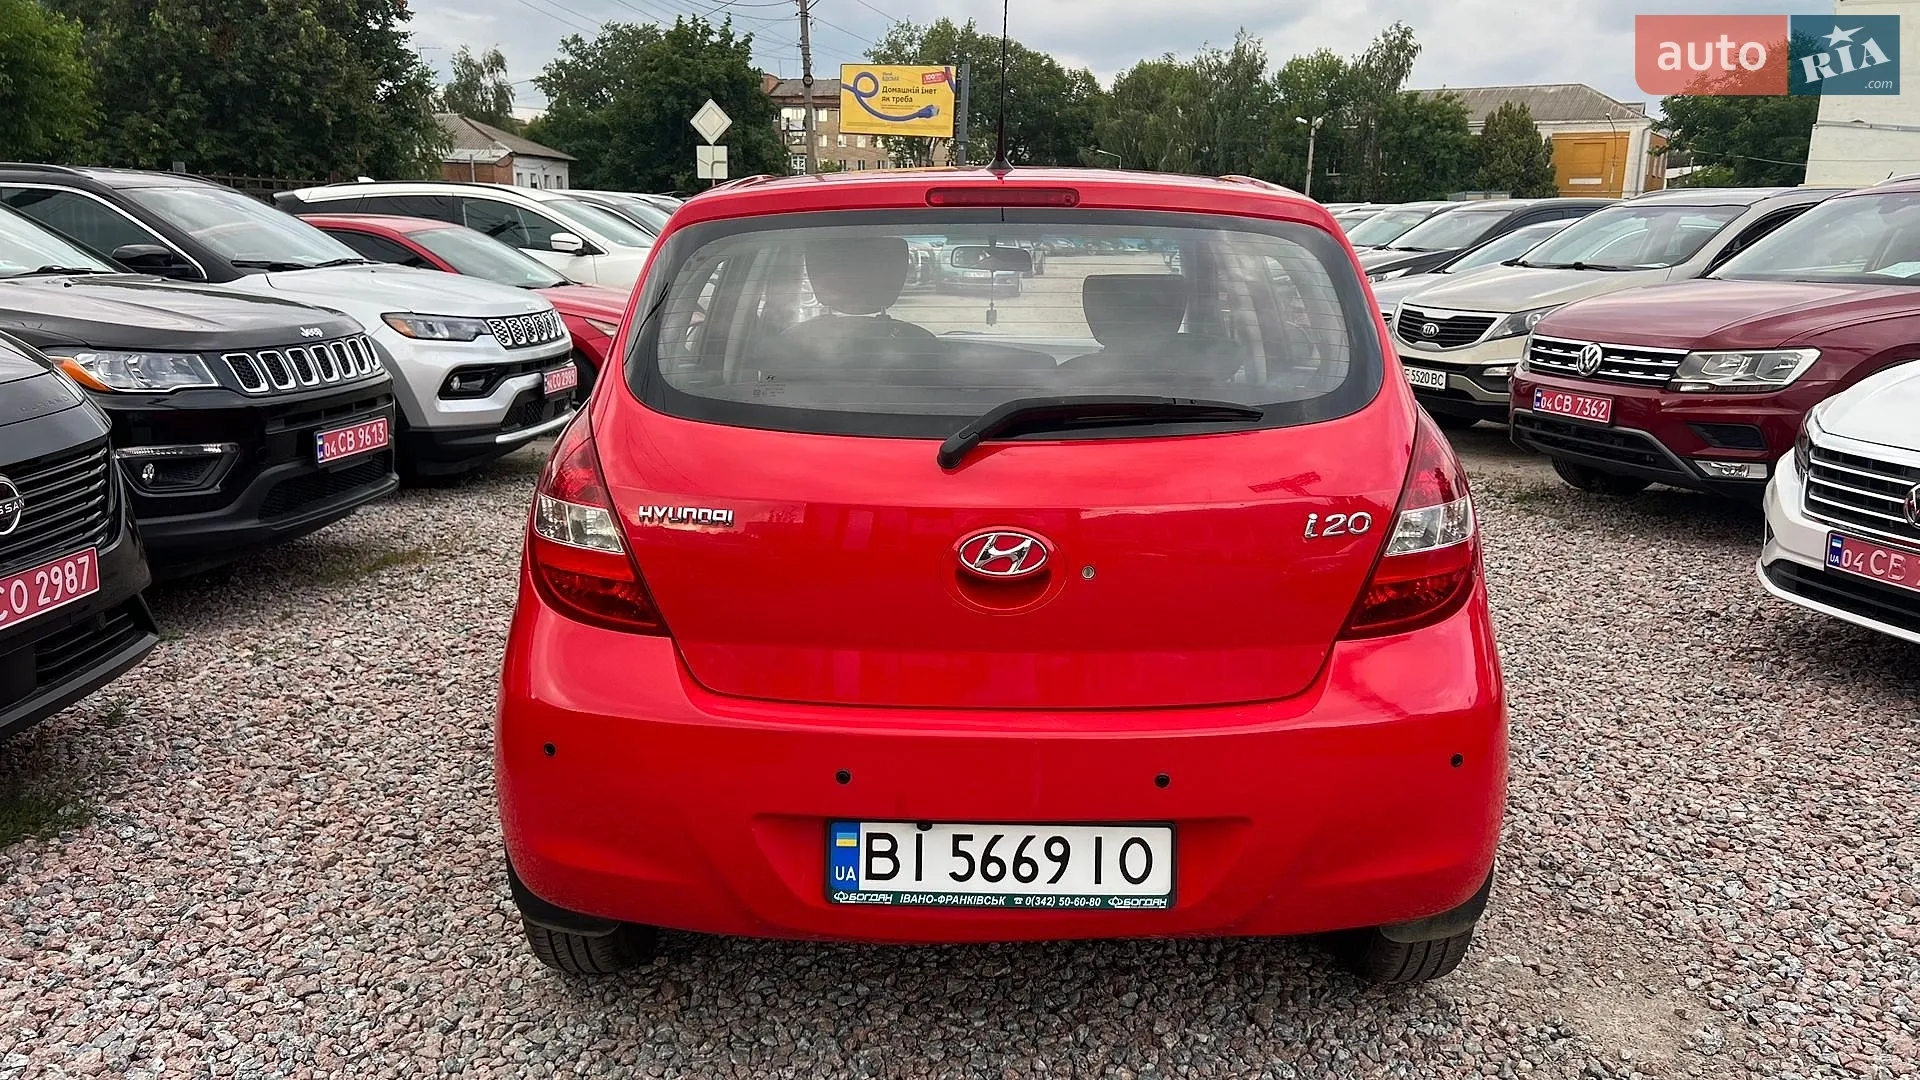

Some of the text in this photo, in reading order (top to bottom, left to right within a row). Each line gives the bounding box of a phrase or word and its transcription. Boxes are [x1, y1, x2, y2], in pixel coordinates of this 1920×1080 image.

[882, 85, 937, 95] Домашній інет
[892, 95, 913, 104] треба
[300, 326, 323, 337] Jeep
[1423, 325, 1435, 335] KIA
[1411, 369, 1430, 384] 5520
[1431, 372, 1444, 386] BC
[1541, 396, 1553, 410] 04
[1554, 394, 1572, 412] CB
[1575, 397, 1607, 419] 7362
[324, 422, 384, 458] 04 CB 9613
[639, 505, 734, 525] HYUNDAI
[1304, 511, 1372, 538] i20
[1829, 553, 1840, 564] UA
[1841, 549, 1865, 573] 04
[34, 554, 90, 607] 2987
[835, 866, 857, 881] UA
[949, 834, 1071, 884] 5669
[1025, 895, 1056, 908] 0(342)
[1058, 896, 1102, 907] 50-60-80
